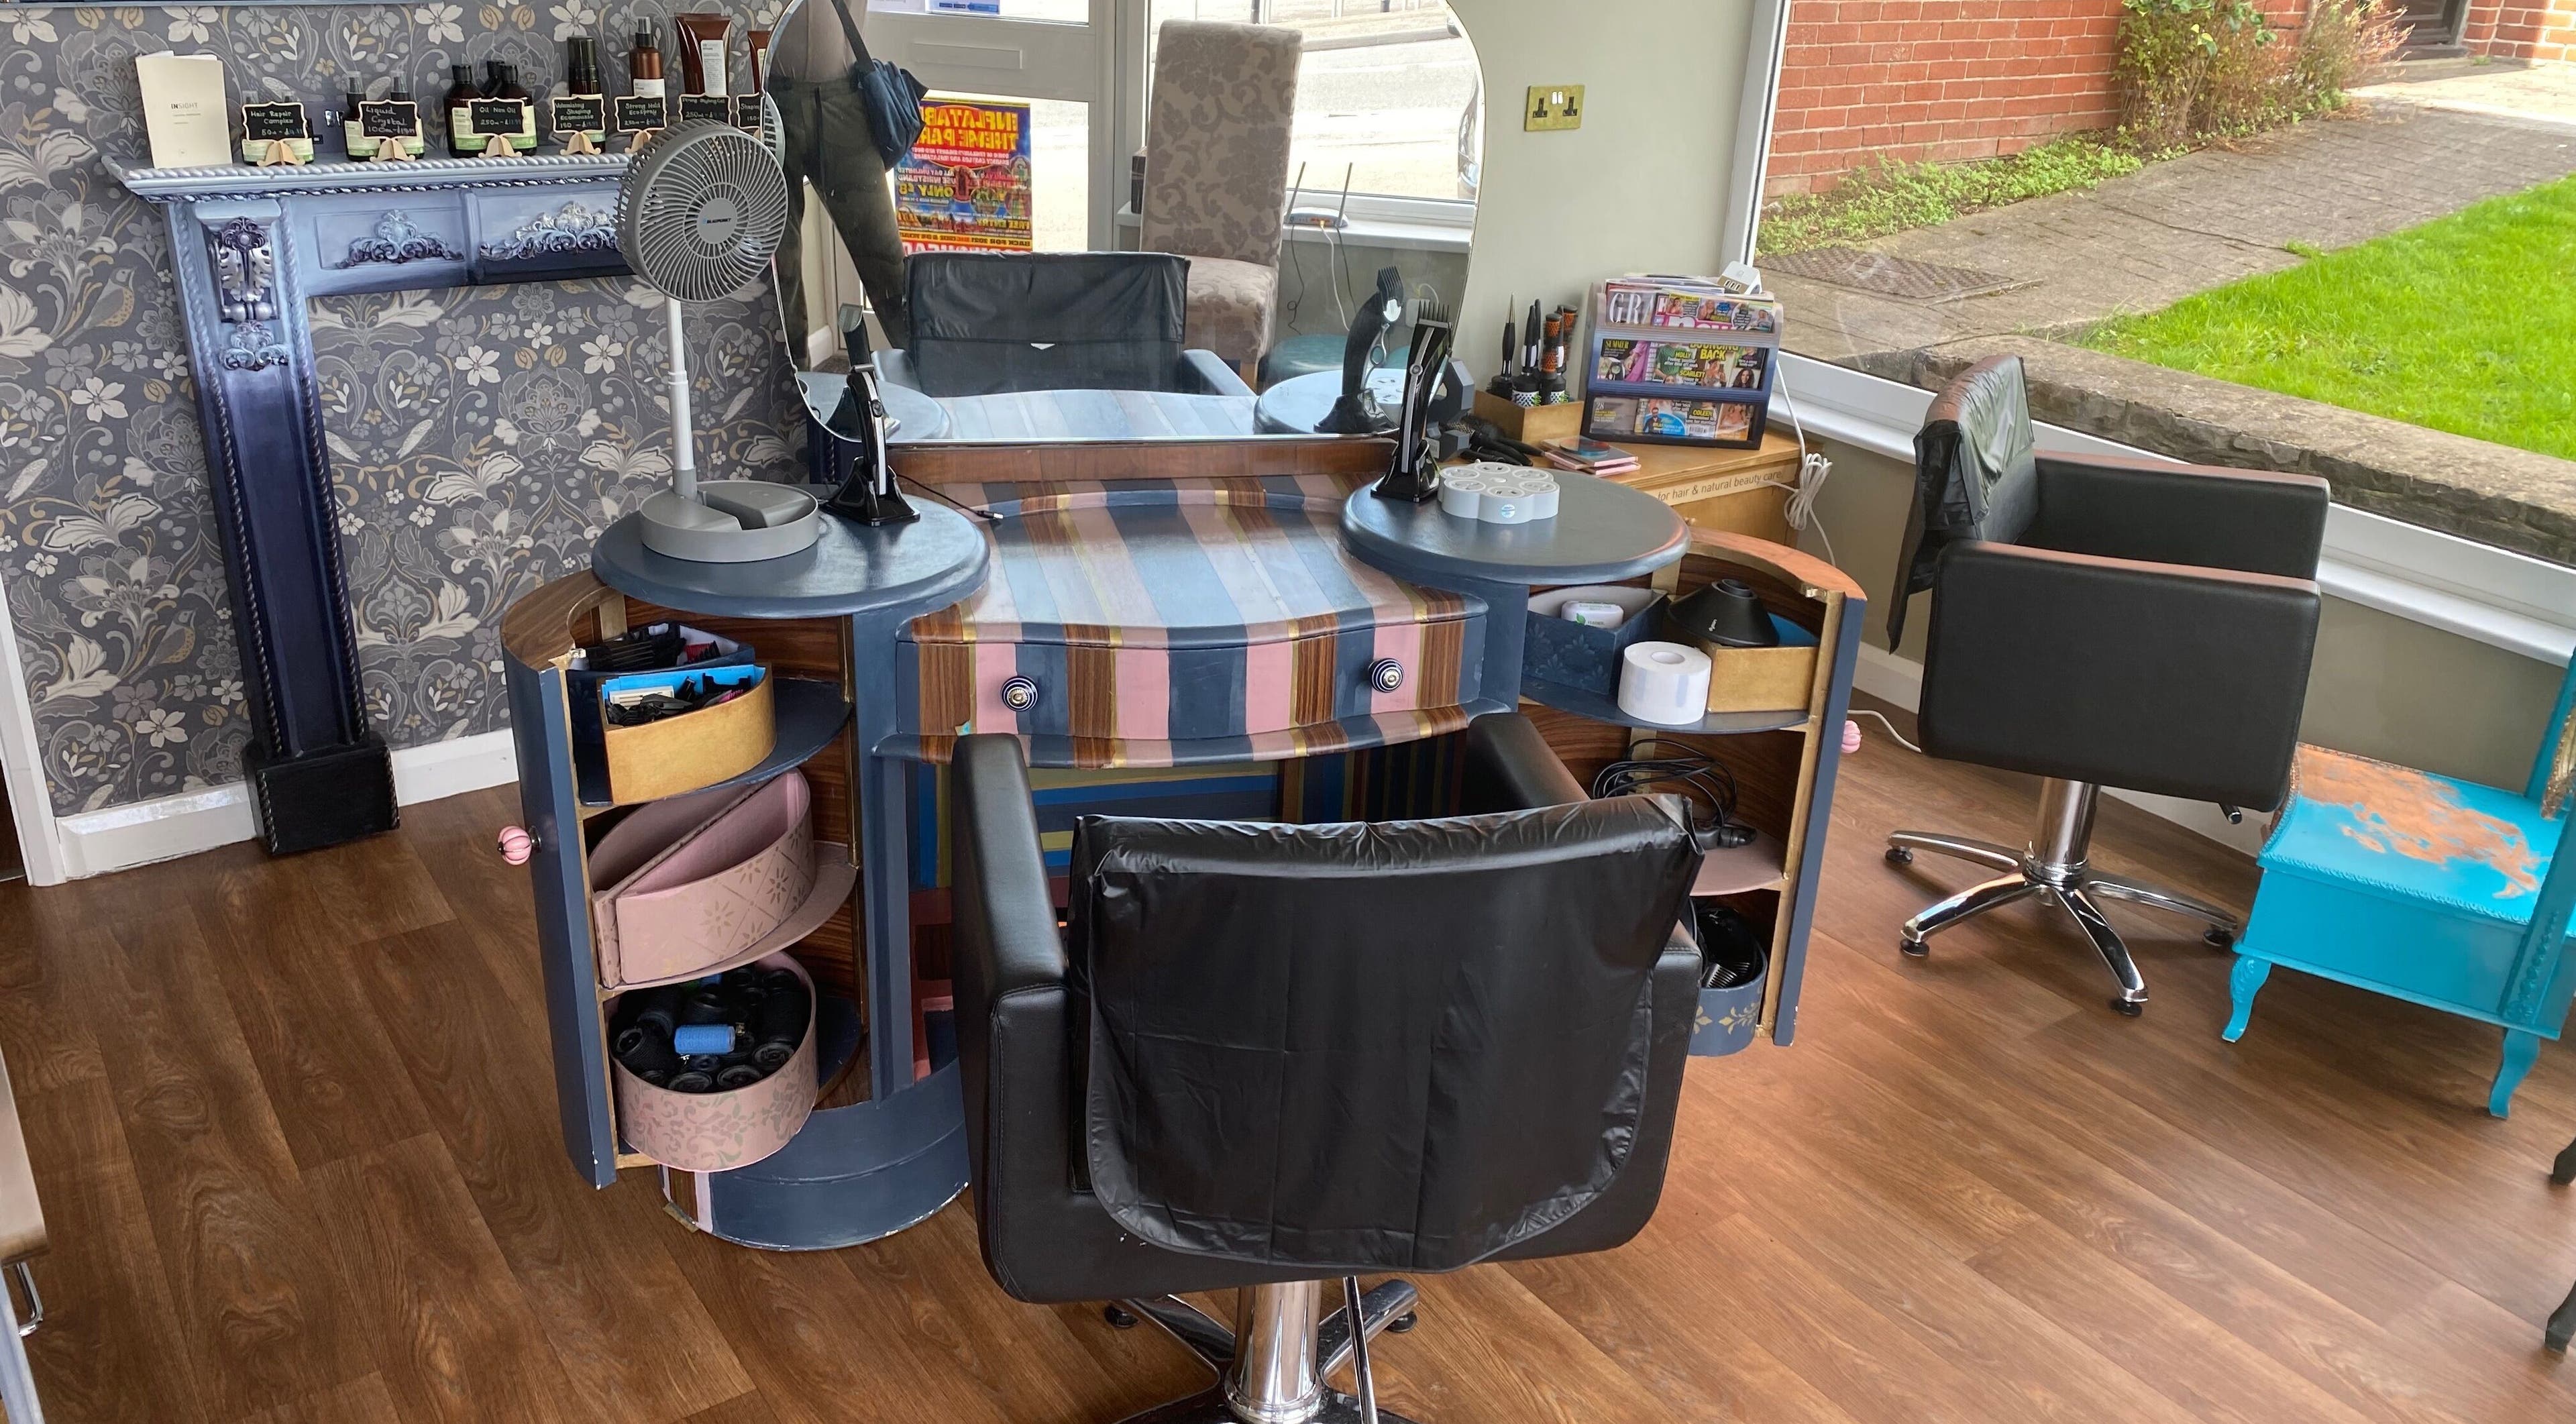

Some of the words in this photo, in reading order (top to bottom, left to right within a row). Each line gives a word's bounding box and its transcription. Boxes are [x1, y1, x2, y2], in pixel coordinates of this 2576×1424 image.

[366, 106, 396, 115] Liquid
[372, 115, 408, 127] Crystal
[1605, 340, 1629, 349] SUMMER
[1700, 348, 1726, 361] BACK
[1673, 488, 1689, 499] hair
[1692, 485, 1699, 495] &
[1701, 479, 1732, 493] natural
[1734, 474, 1762, 487] beauty
